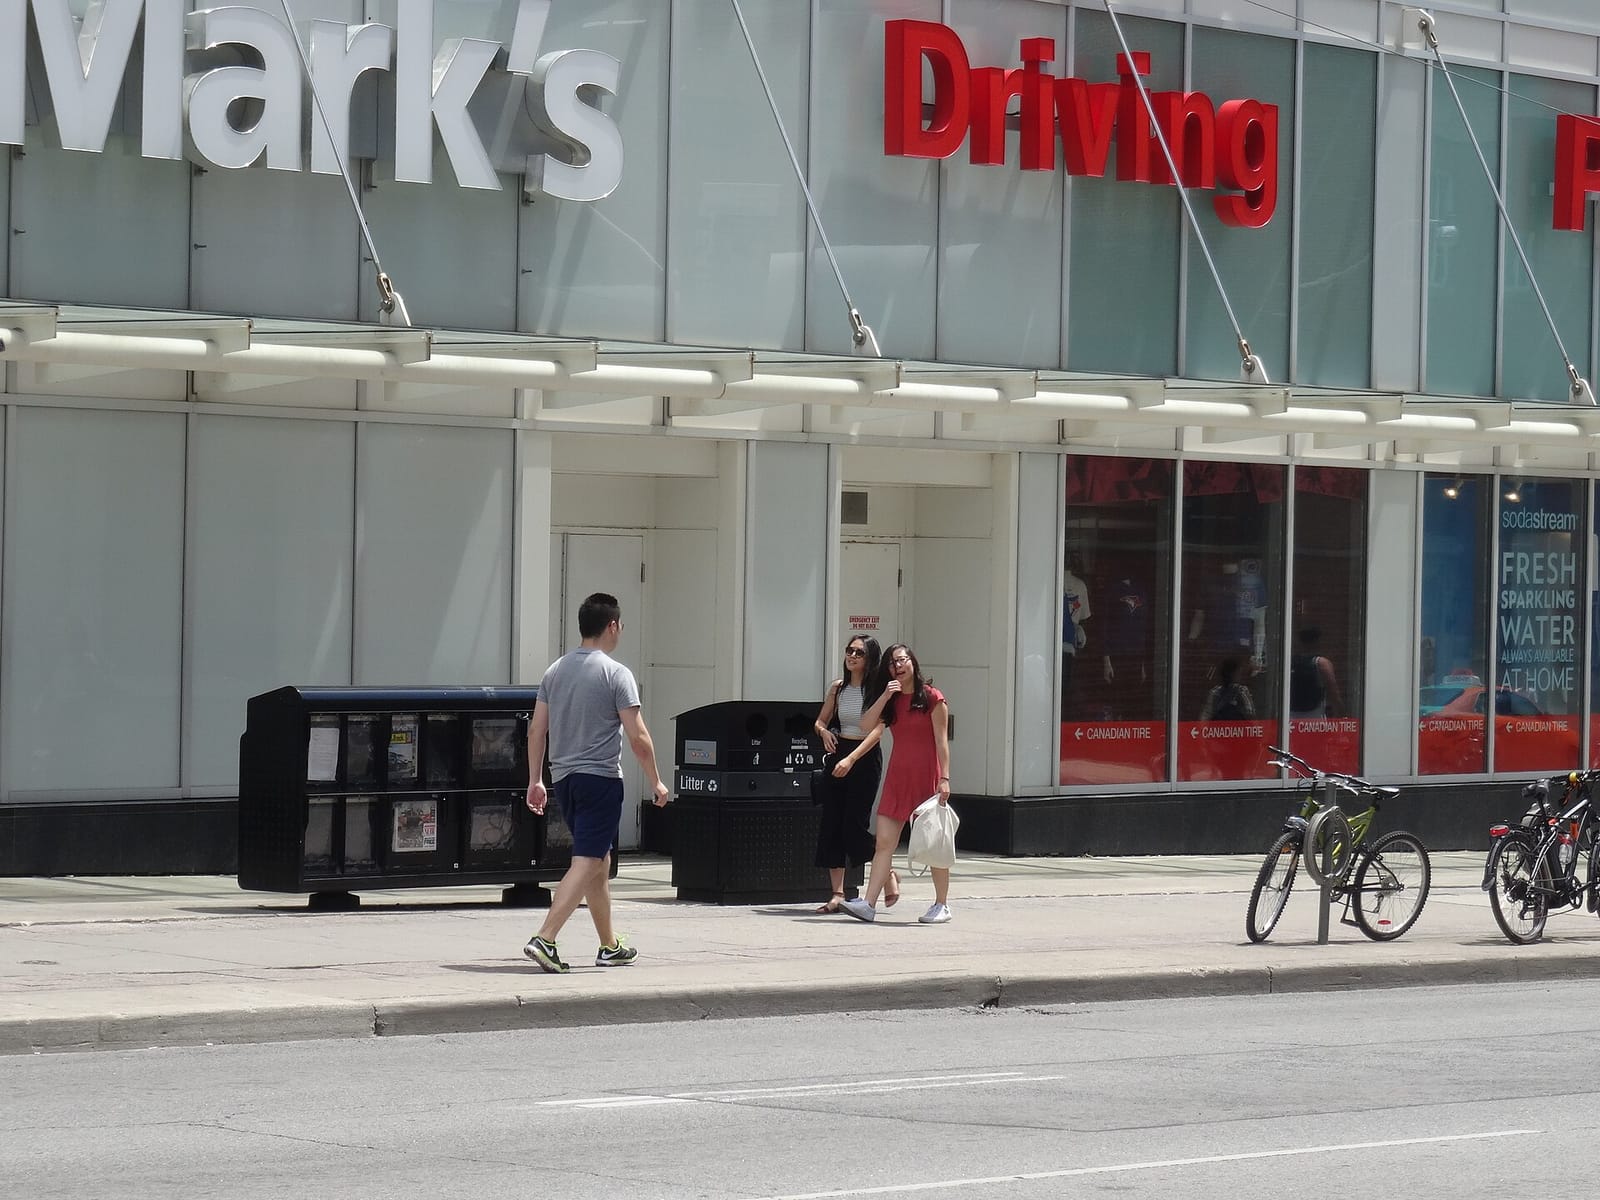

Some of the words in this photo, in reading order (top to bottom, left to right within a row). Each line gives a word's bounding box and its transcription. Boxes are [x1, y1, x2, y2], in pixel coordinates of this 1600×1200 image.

[0, 0, 625, 202] Mark's
[884, 18, 1278, 228] Driving
[1502, 507, 1576, 530] sodastream
[1503, 552, 1575, 584] FRESH
[1501, 590, 1575, 609] SPARKLING
[1501, 615, 1575, 645] WATER
[1501, 649, 1532, 663] ALWAYS
[1534, 648, 1574, 663] AVAILABLE
[1501, 668, 1520, 692] AT
[1525, 667, 1574, 692] HOME
[1202, 726, 1244, 739] CANADIAN
[1245, 726, 1263, 738] TIRE
[1298, 721, 1338, 733] CANADIAN
[1339, 721, 1357, 733] TIRE
[1429, 720, 1466, 731] CANADIAN
[1467, 719, 1484, 730] TIRE
[1515, 721, 1551, 732] CANADIAN
[1552, 720, 1568, 732] TIRE
[1086, 727, 1131, 740] CANADIAN
[1132, 727, 1151, 739] TIRE
[751, 738, 761, 746] Litter
[680, 775, 704, 791] Litter
